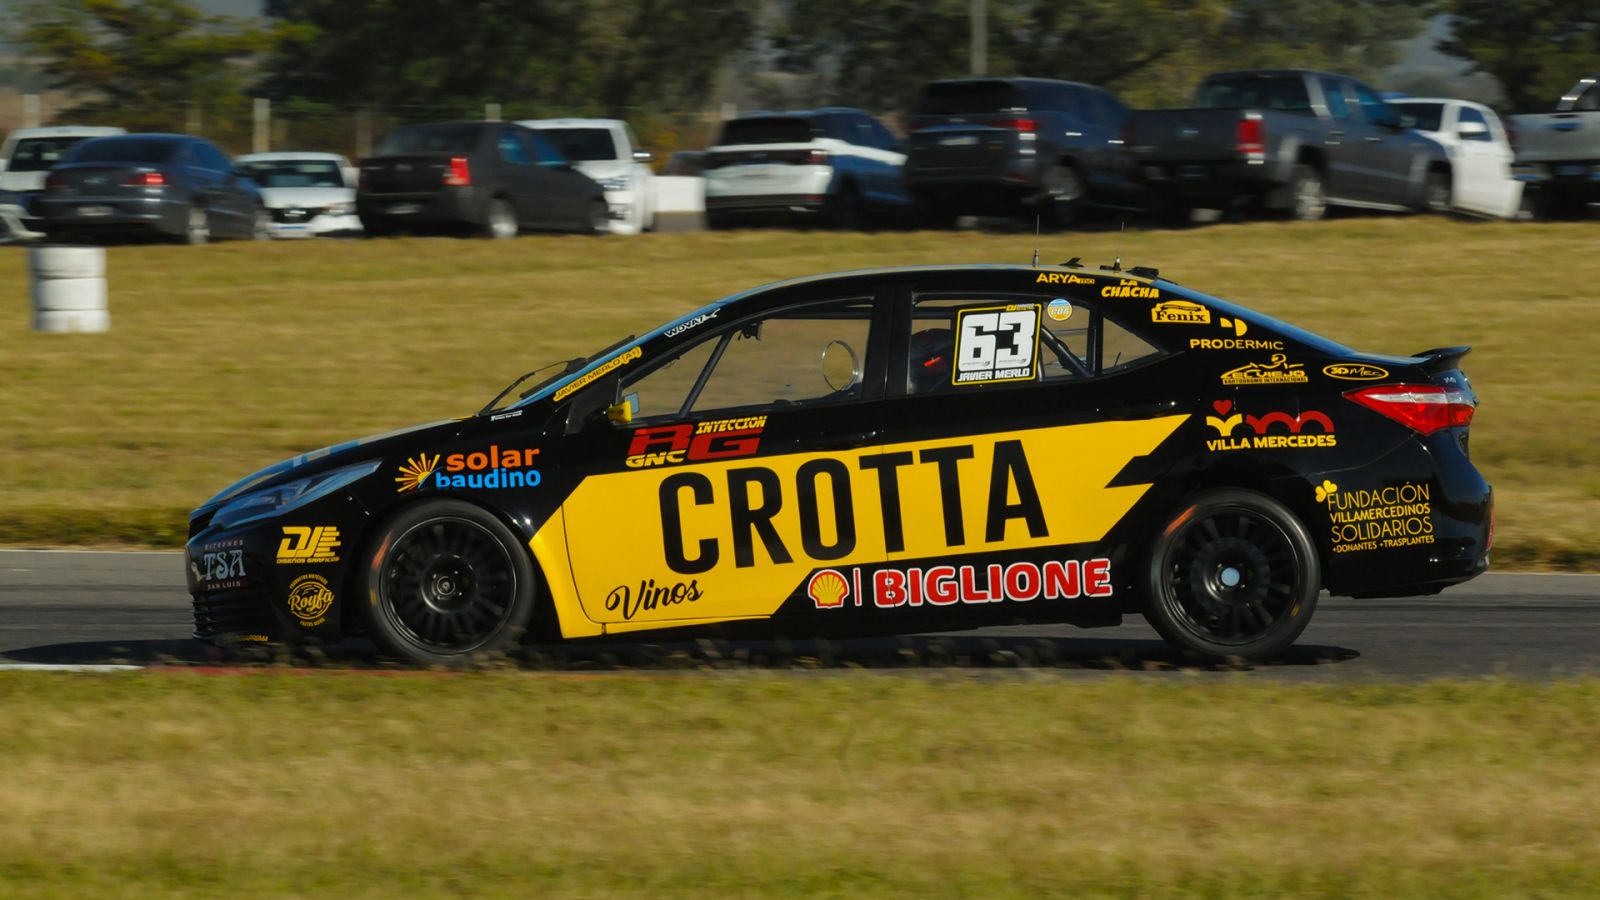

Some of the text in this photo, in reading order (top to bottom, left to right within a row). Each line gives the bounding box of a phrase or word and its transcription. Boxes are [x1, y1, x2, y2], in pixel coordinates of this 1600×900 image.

[1036, 273, 1079, 284] ARYA
[1101, 286, 1159, 299] CHACHA
[1156, 311, 1206, 322] Fenix
[958, 311, 1036, 371] 63
[1190, 339, 1284, 351] PRODERMIC
[555, 377, 587, 400] JAVIER
[587, 358, 621, 382] MERLO
[957, 368, 1035, 382] JAVIER MERLO
[1330, 367, 1348, 375] 3D
[696, 416, 767, 435] INYECCION
[627, 424, 763, 460] RG
[1207, 434, 1336, 451] VILLA MERCEDES
[446, 445, 541, 472] solar
[625, 449, 687, 467] GNC
[436, 468, 542, 489] baudino
[658, 439, 1050, 575] CROTTA
[1327, 481, 1431, 511] FUNDACIÓN
[1329, 502, 1432, 524] VILLAMERCEDINOS
[1331, 516, 1434, 543] SOLIDARIOS
[204, 549, 246, 580] TSA
[872, 557, 1113, 609] BIGLIONE
[288, 589, 335, 612] Royfa
[605, 579, 704, 621] Vinos
